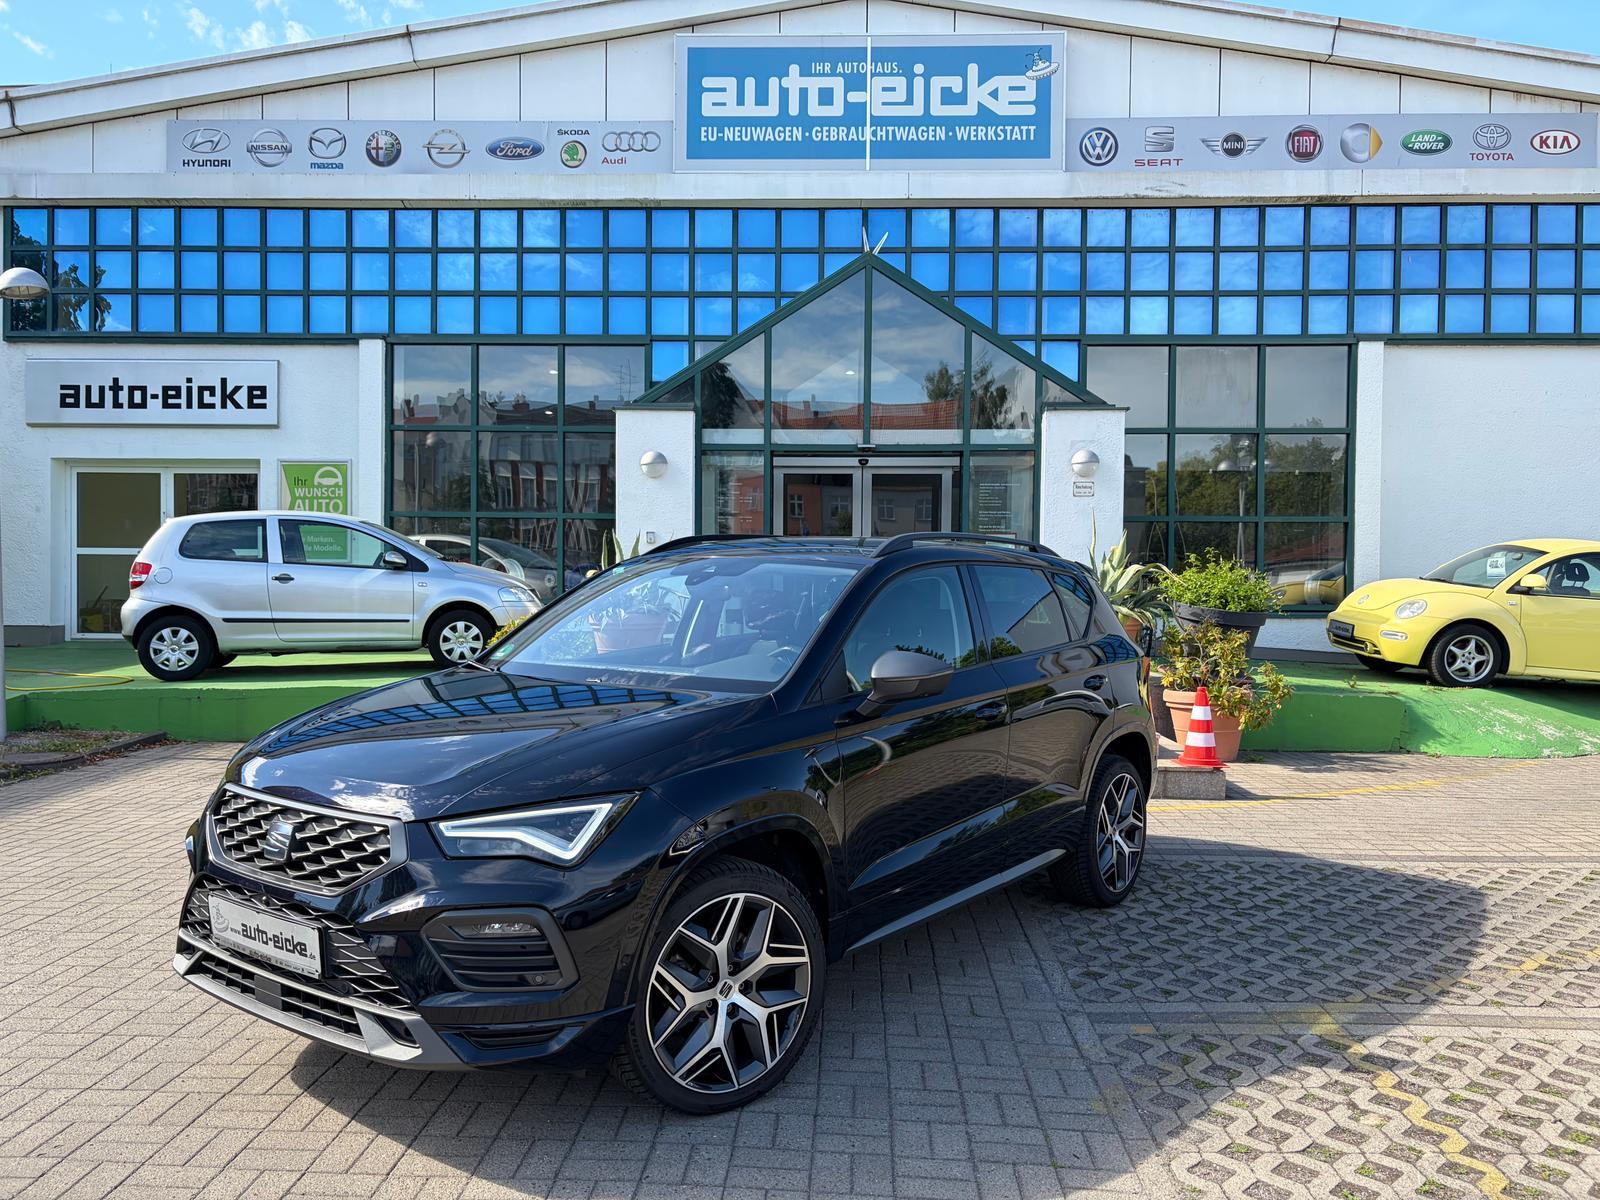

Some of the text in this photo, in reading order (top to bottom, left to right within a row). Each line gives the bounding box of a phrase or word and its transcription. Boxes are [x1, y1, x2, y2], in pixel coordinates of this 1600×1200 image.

[811, 61, 903, 74] IHR AUTOHAUS.
[701, 63, 1037, 117] auto-eicke
[557, 128, 590, 136] ŠKODA
[700, 125, 1037, 142] EU-NEUWAGEN GEBRAUCHTWAGEN WERKSTATT
[1223, 141, 1244, 151] MINI
[1294, 135, 1316, 153] FIAT
[1412, 142, 1445, 150] ROVER
[1539, 136, 1573, 149] KIA
[496, 139, 534, 157] Ford
[601, 157, 627, 165] Audi
[1469, 153, 1514, 161] TOYOTA
[182, 159, 231, 168] HYUNDAI
[1134, 158, 1184, 167] SEAT
[59, 377, 268, 410] auto-eicke
[293, 476, 307, 486] Ihr
[294, 487, 344, 497] WUNSCH
[294, 498, 344, 514] AUTO
